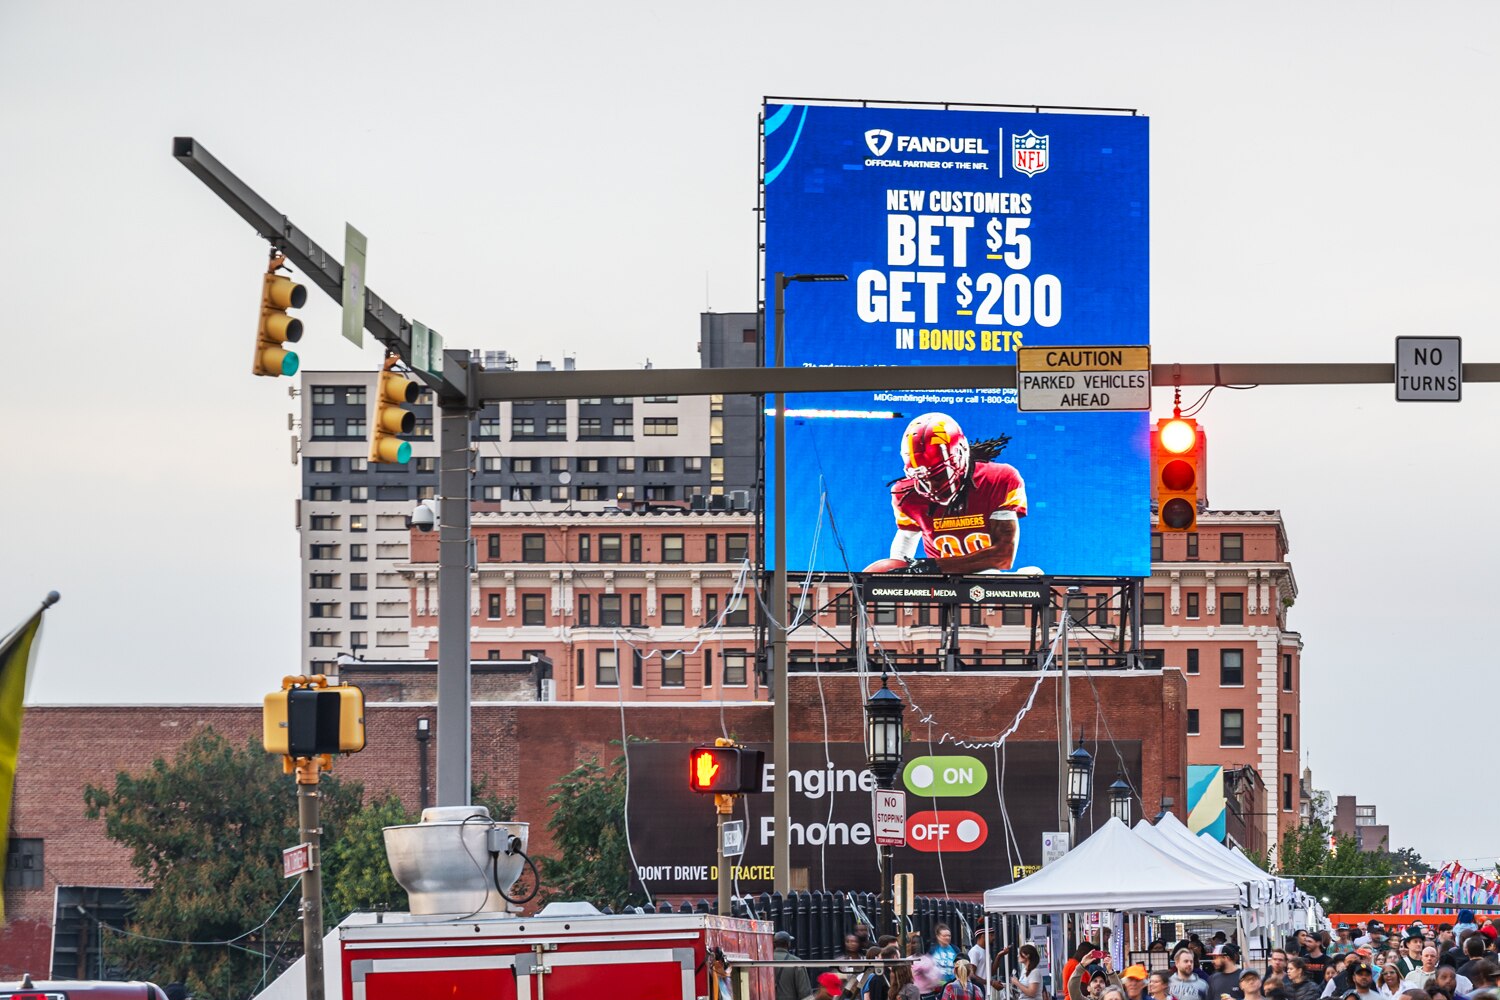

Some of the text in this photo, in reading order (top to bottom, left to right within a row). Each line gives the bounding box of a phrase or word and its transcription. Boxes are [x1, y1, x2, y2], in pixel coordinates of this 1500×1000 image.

[897, 136, 989, 154] FANDUEL
[865, 159, 902, 168] OFFICIAL
[903, 160, 940, 169] PARTNER
[942, 161, 954, 169] OF
[955, 162, 971, 170] THE
[1017, 150, 1044, 170] NFL
[887, 190, 1032, 214] NEW CUSTOMERS
[887, 214, 1032, 270] BET $5
[857, 269, 1062, 328] GET $200
[896, 328, 1023, 352] IN BONUS BETS
[1046, 352, 1122, 367] CAUTION
[1414, 348, 1443, 366] NO
[1023, 374, 1145, 390] PARKED VEHICLES
[1401, 376, 1457, 392] TURNS
[874, 393, 955, 405] MDGamblingHelp.org
[965, 395, 979, 403] call
[1060, 392, 1110, 407] AHEAD
[872, 588, 957, 597] ORANGE BARREL MEDIA
[985, 590, 1018, 598] SHANKLIN
[761, 762, 876, 799] Engine
[943, 767, 973, 784] ON
[884, 796, 897, 808] NO
[877, 813, 903, 824] STOPPING
[760, 816, 871, 847] Phone
[911, 824, 950, 841] OFF
[639, 865, 775, 880] DON'T DRIVE DTRACTED
